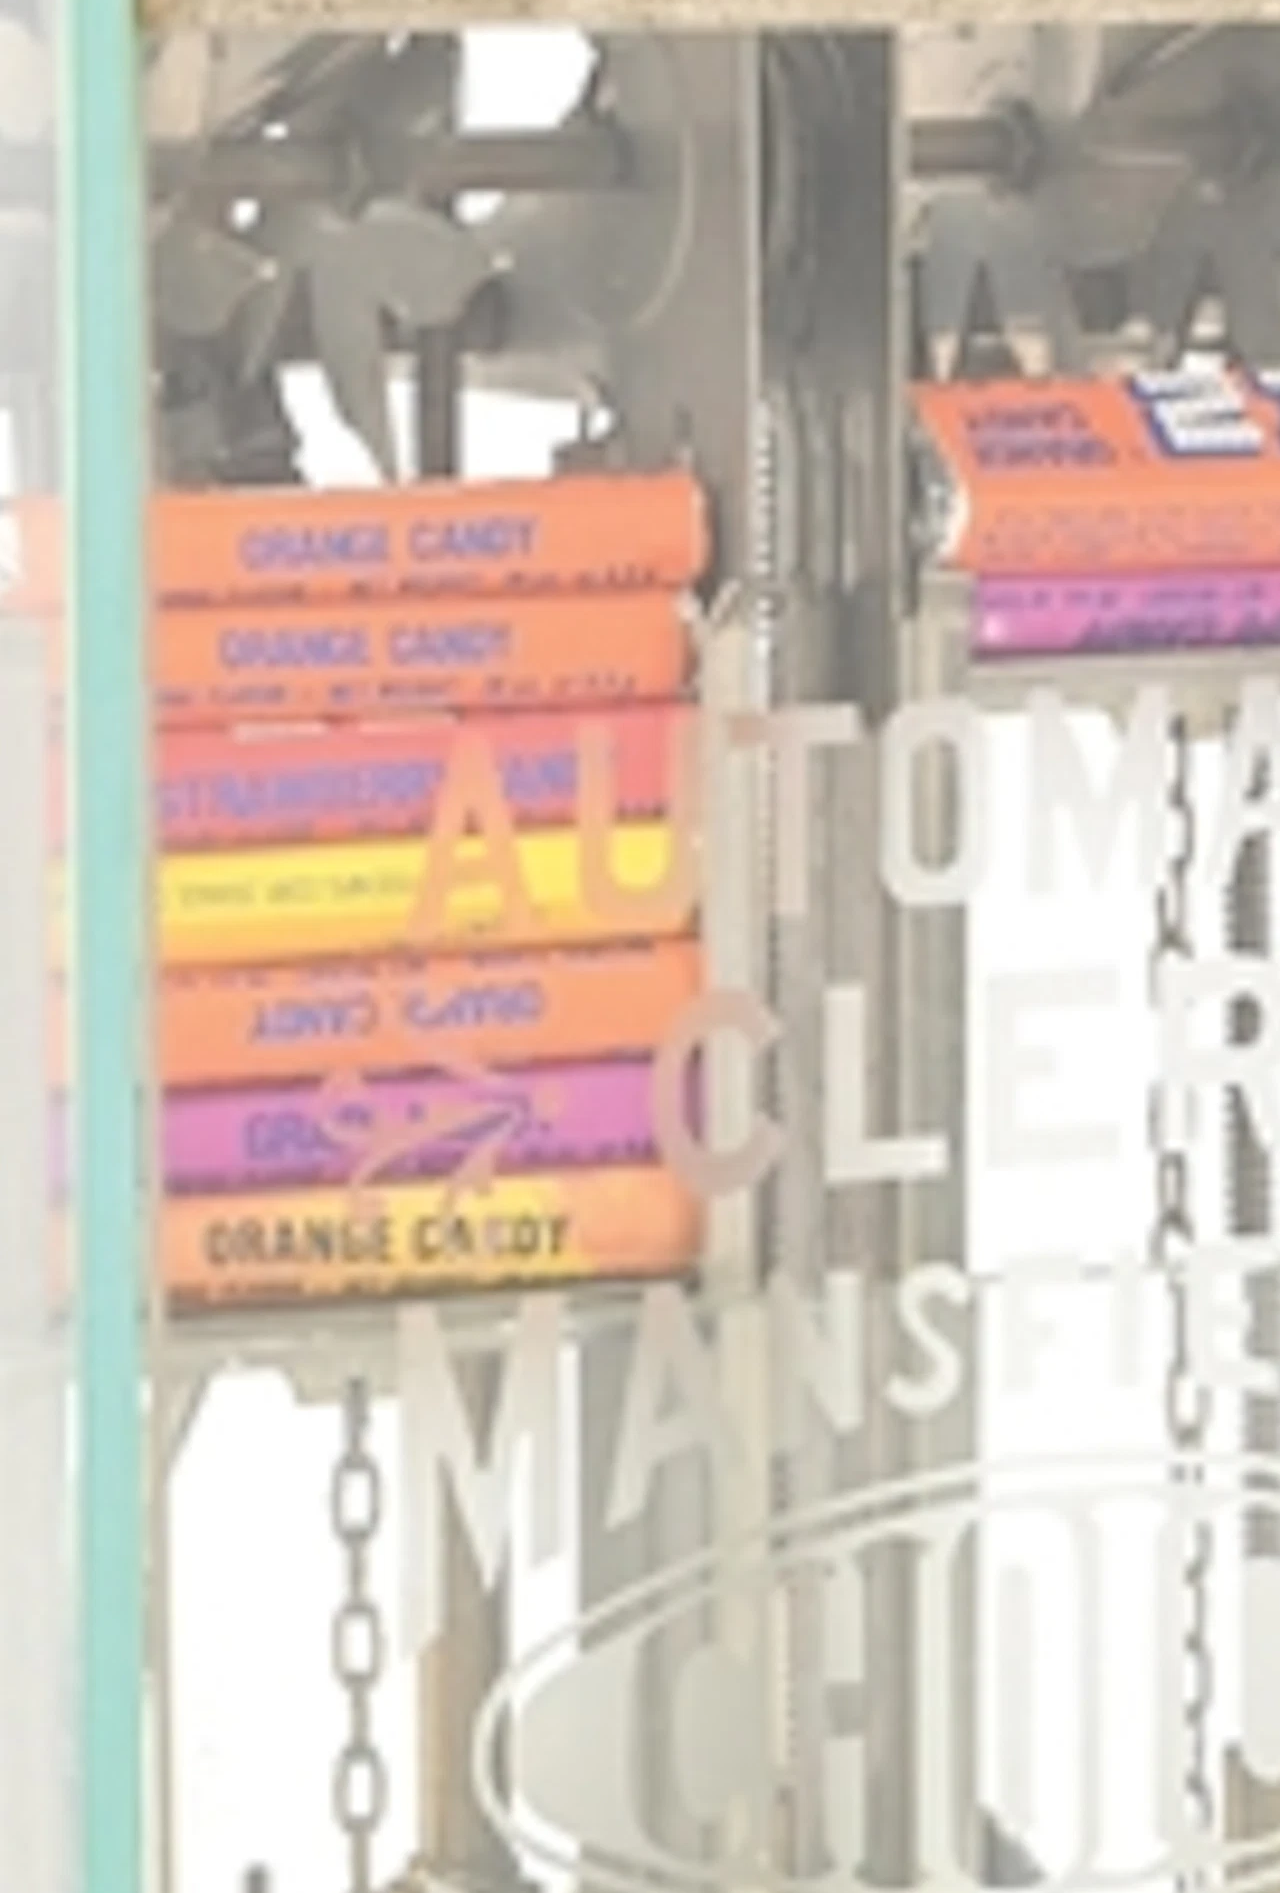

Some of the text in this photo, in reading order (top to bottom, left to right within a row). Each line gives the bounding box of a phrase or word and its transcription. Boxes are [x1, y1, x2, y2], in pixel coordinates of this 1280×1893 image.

[238, 514, 540, 571] ORANGE CANDY
[219, 621, 514, 670] ORANGE CANDY
